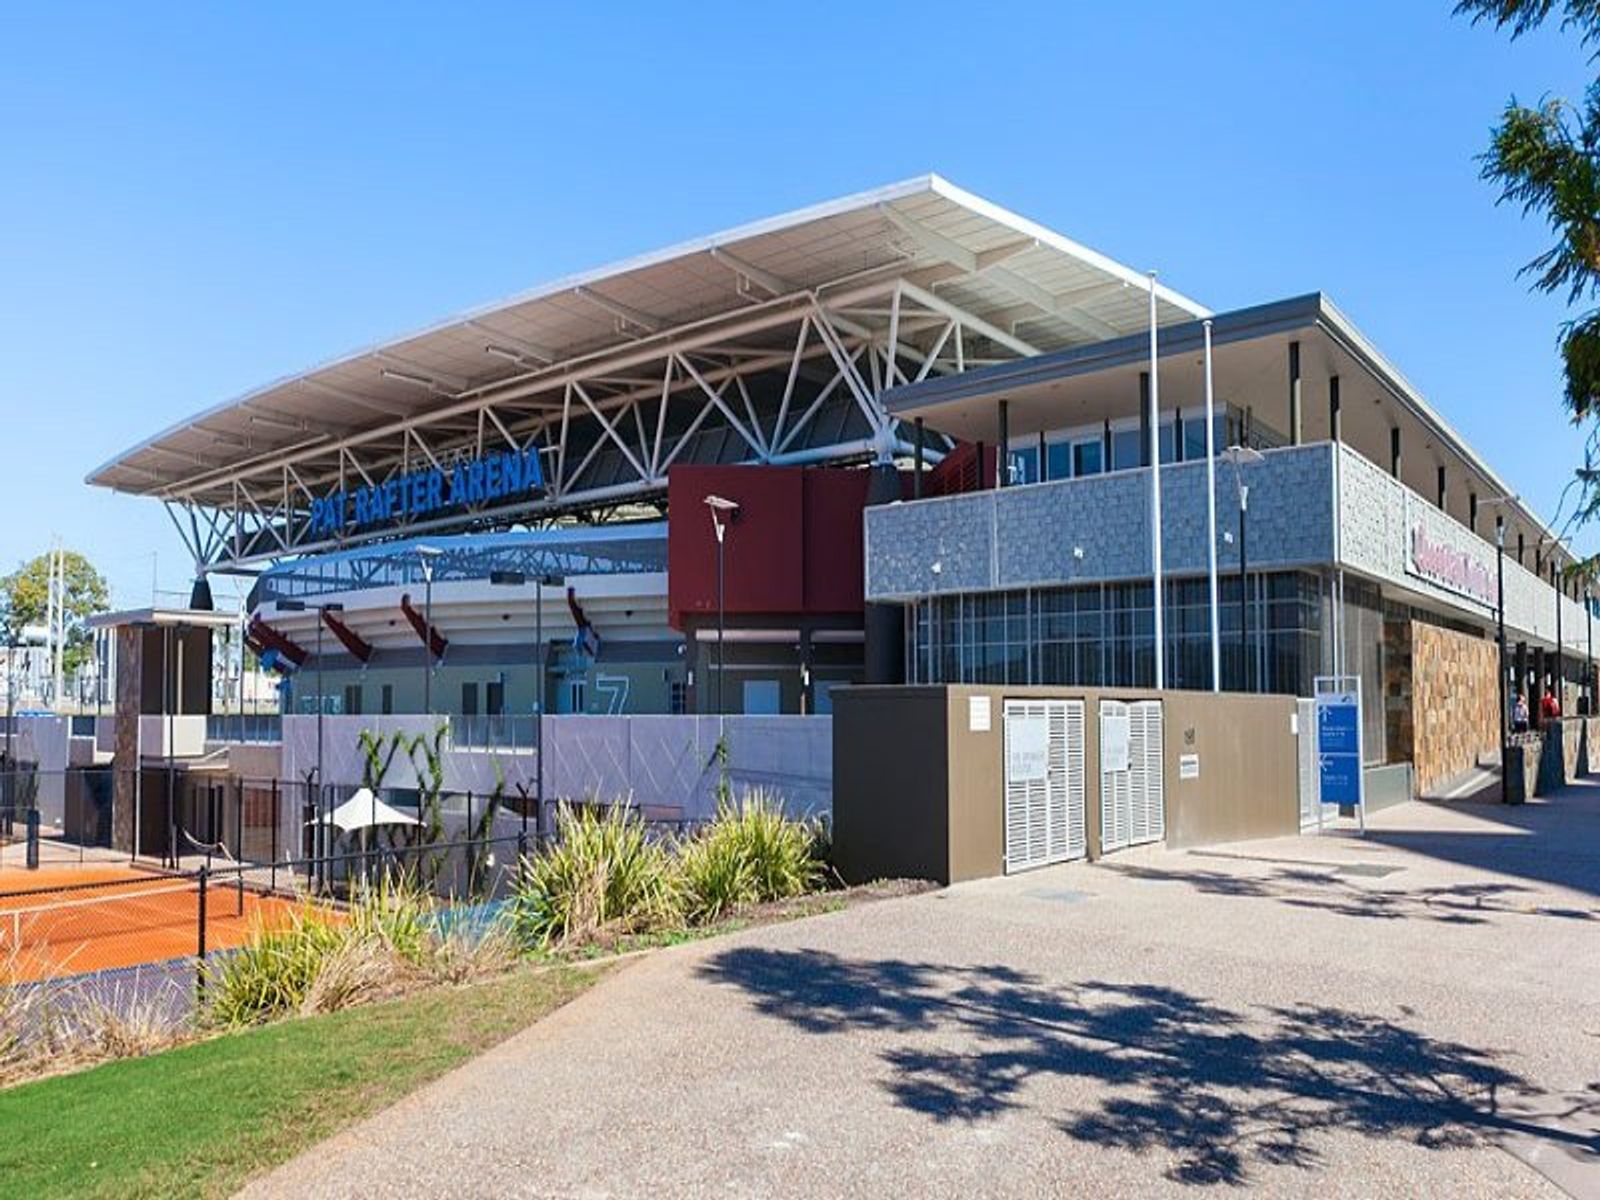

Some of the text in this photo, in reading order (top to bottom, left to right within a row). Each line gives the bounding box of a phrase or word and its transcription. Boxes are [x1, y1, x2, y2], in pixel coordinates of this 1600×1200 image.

[311, 446, 543, 536] PAT RAFTER ARENA
[595, 675, 630, 716] 7
